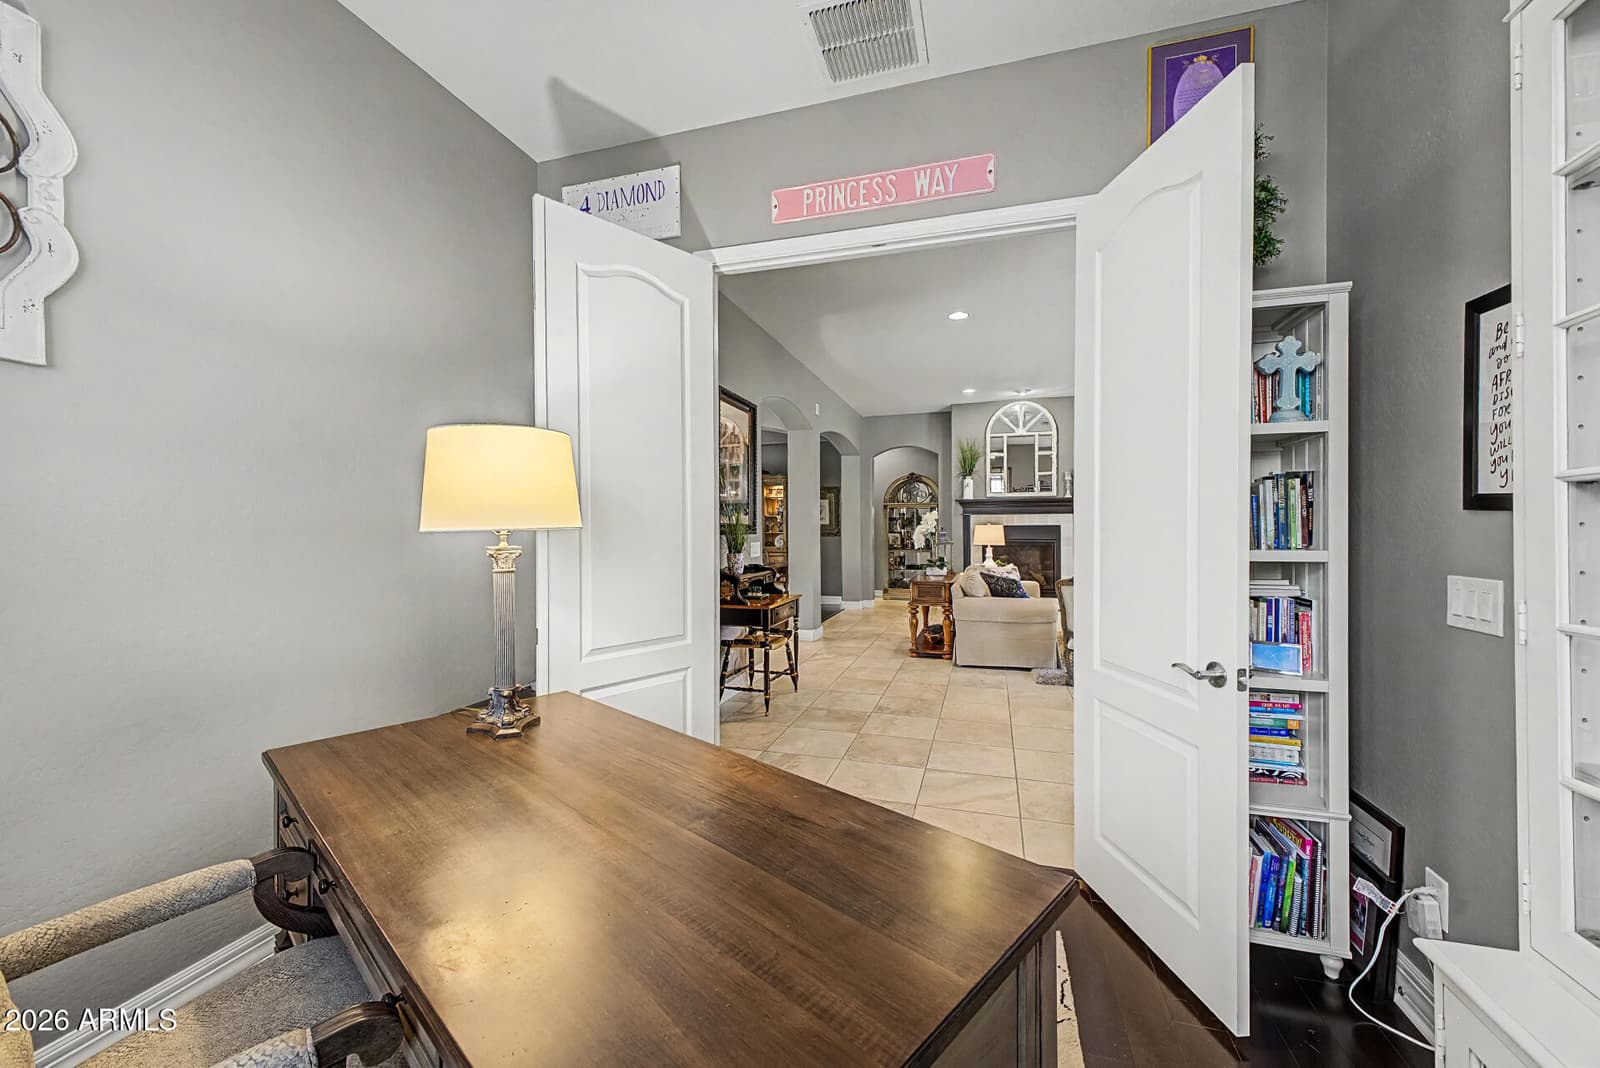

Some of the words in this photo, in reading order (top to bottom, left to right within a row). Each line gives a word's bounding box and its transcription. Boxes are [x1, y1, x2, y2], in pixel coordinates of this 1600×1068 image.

[579, 195, 592, 214] 4
[596, 180, 665, 213] DIAMOND
[802, 174, 897, 217] PRINCESS
[914, 163, 959, 198] WAY
[1495, 321, 1509, 342] Be
[1488, 335, 1508, 359] and
[1491, 369, 1512, 393] AFR
[1492, 387, 1513, 406] DIS
